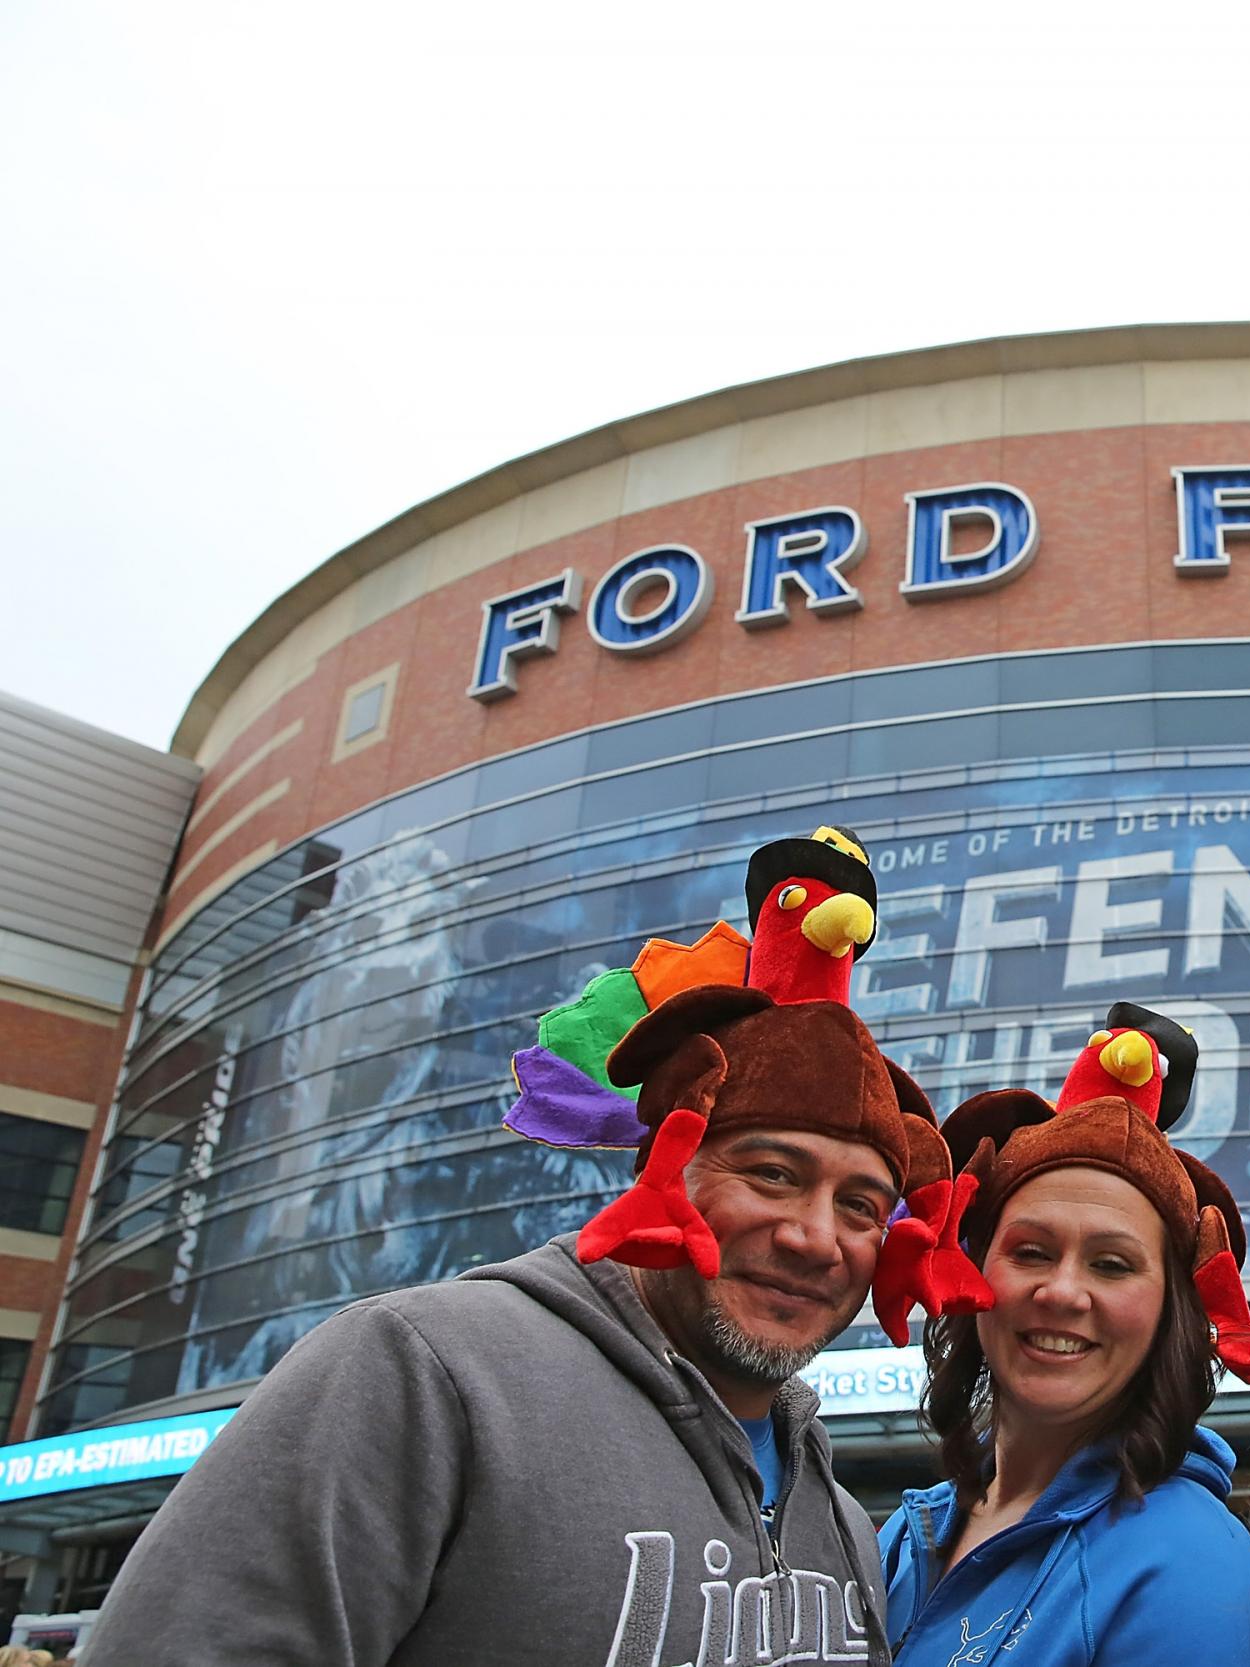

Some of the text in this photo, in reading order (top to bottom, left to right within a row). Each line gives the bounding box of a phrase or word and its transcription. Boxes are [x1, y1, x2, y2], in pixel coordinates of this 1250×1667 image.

[466, 481, 1040, 703] FORD
[877, 840, 949, 873] OME
[968, 829, 1012, 856] OF
[1031, 816, 1096, 847] THE
[806, 1365, 922, 1399] rket Sty
[5, 1427, 209, 1486] TO EPA-ESTIMATED
